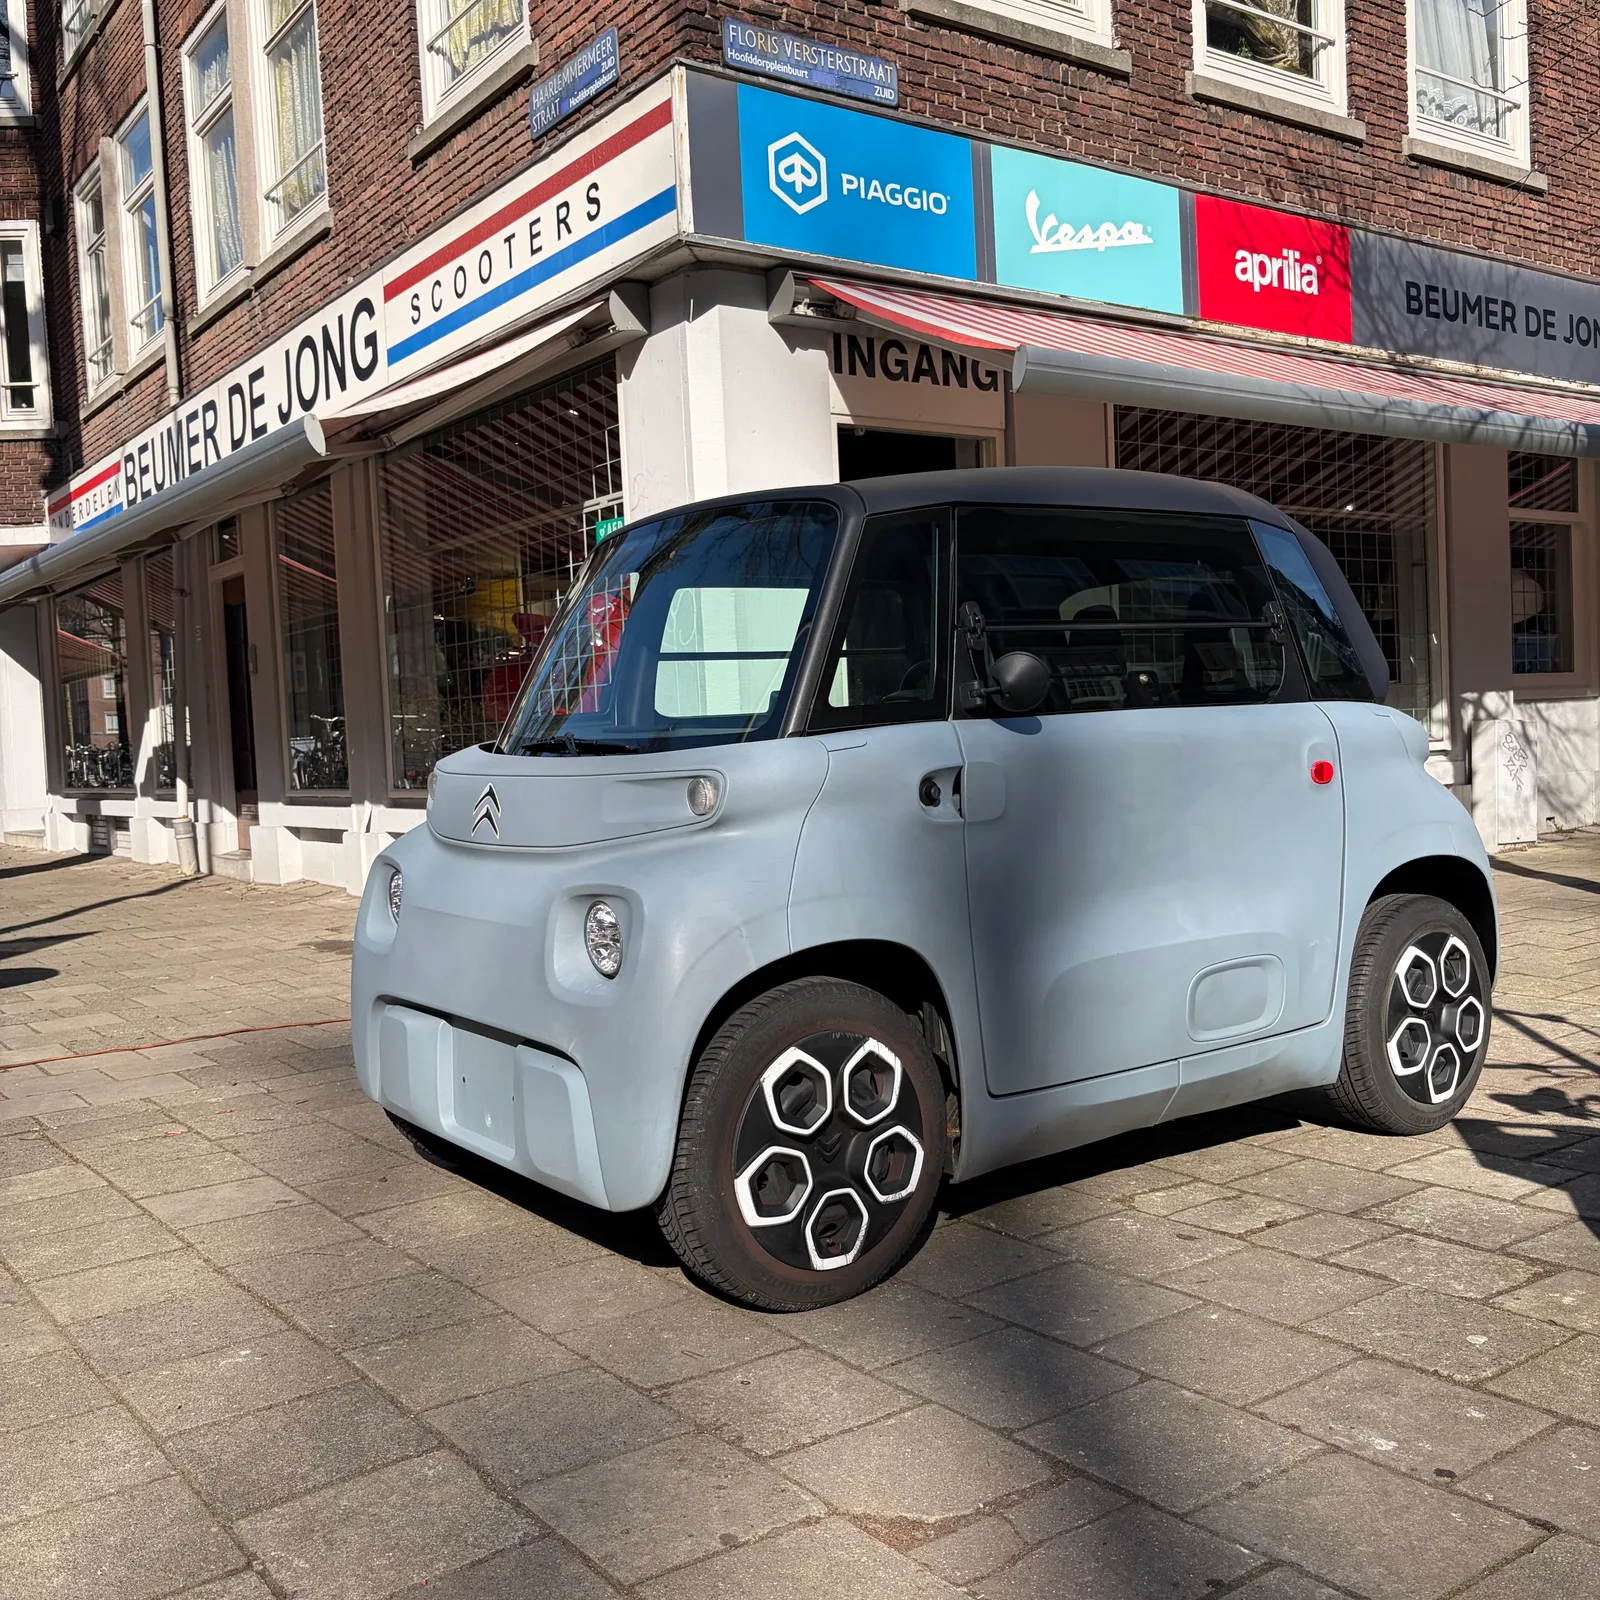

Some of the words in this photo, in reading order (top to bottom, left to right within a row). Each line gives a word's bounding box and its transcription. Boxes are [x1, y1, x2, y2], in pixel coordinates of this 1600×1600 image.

[532, 36, 613, 111] HAARLEMMERMEER
[601, 56, 615, 73] ZUID
[727, 48, 809, 79] Hoofddorppleinbuurt
[729, 24, 779, 55] FLORIS
[784, 38, 893, 84] VERSTERSTRAAT
[532, 98, 560, 133] STRAAT
[569, 69, 616, 108] Hoofddorppleinbuurt
[873, 85, 895, 100] ZUID
[841, 173, 947, 215] PIAGGIO
[1025, 189, 1153, 253] Vespa
[410, 182, 601, 325] SCOOTERS
[1235, 248, 1319, 296] aprilia
[1405, 280, 1518, 334] BEUMER
[1524, 305, 1557, 341] DE
[833, 332, 999, 392] INGANG
[123, 399, 222, 507] BEUMER
[228, 365, 268, 452] DE
[278, 297, 379, 425] JONG
[51, 477, 121, 531] ONDERDELEN
